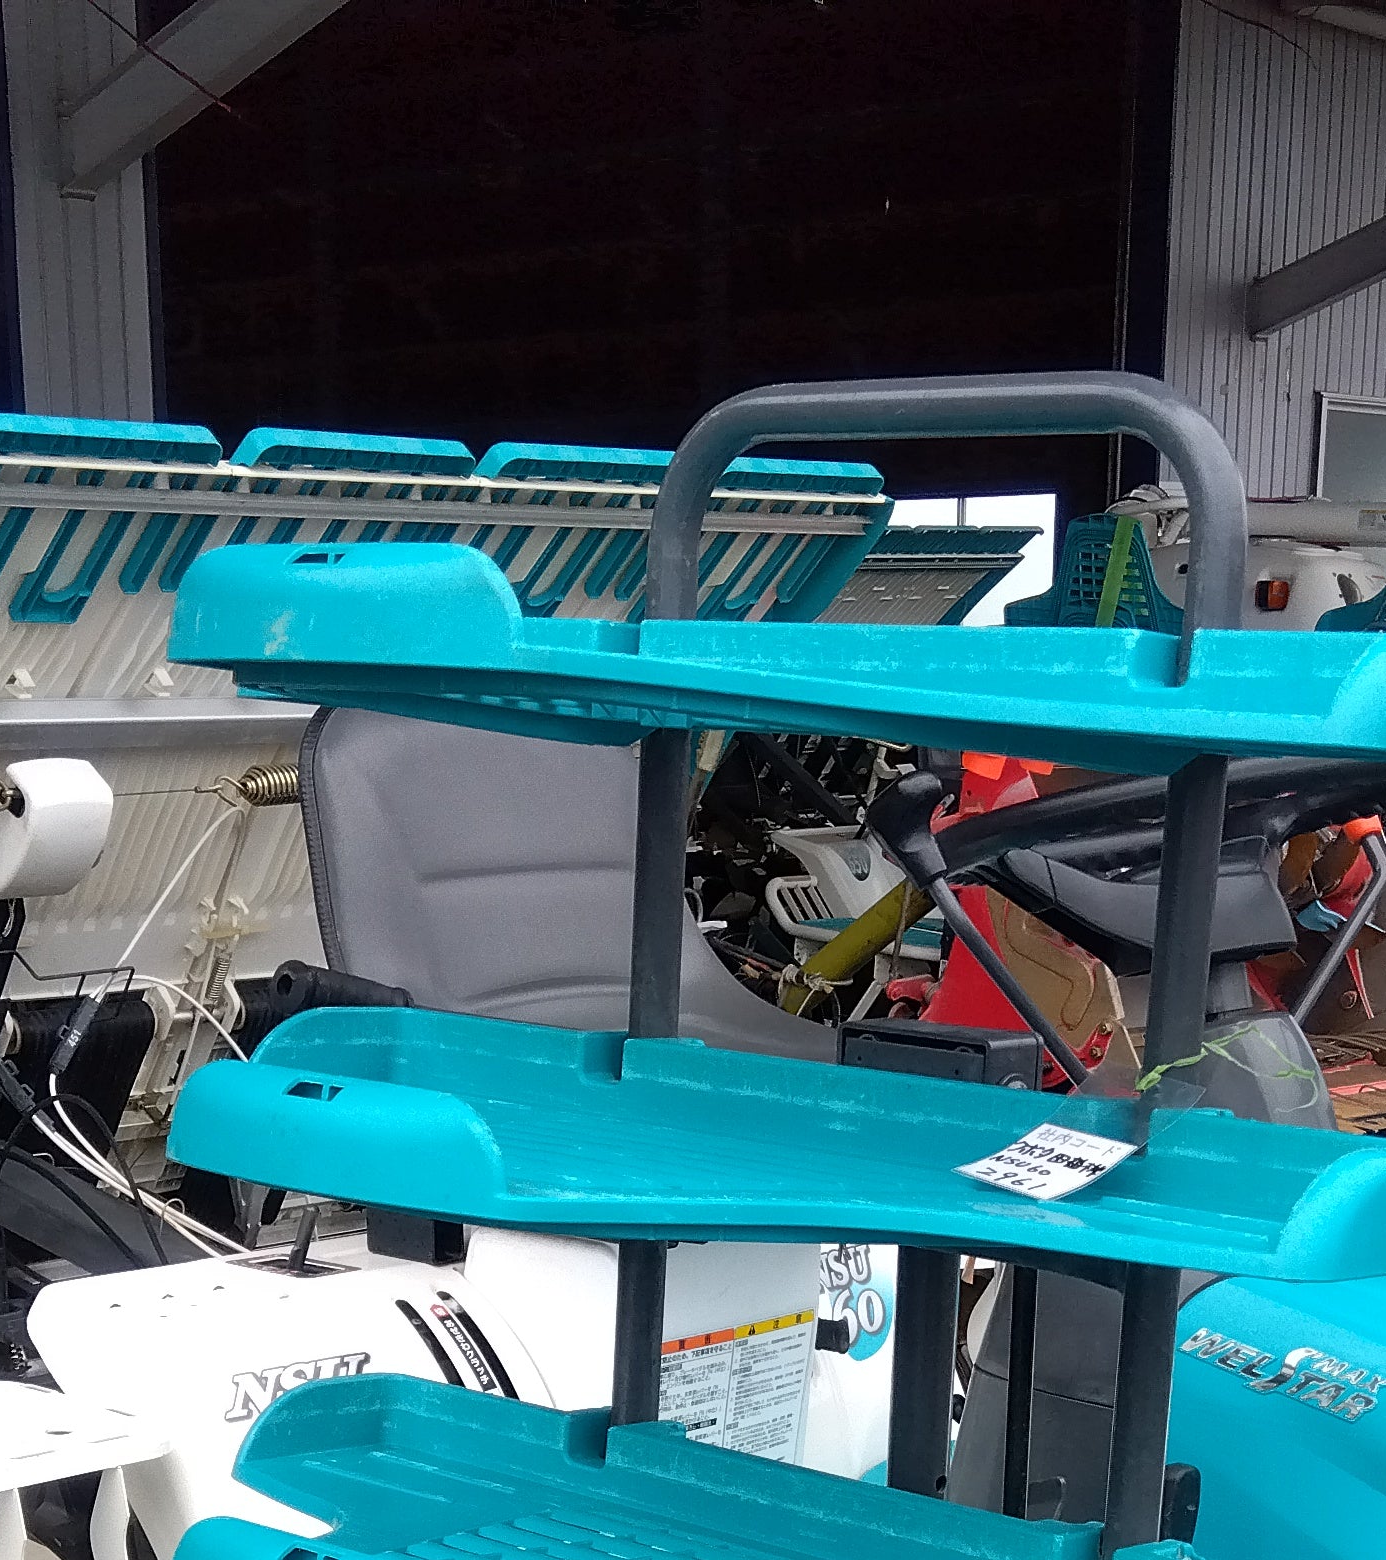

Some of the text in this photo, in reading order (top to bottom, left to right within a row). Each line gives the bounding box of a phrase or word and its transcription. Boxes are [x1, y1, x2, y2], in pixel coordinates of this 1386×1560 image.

[68, 1029, 82, 1047] 451
[975, 1166, 1047, 1191] 2961
[832, 1287, 886, 1348] 60
[1178, 1327, 1379, 1423] WELSTAR
